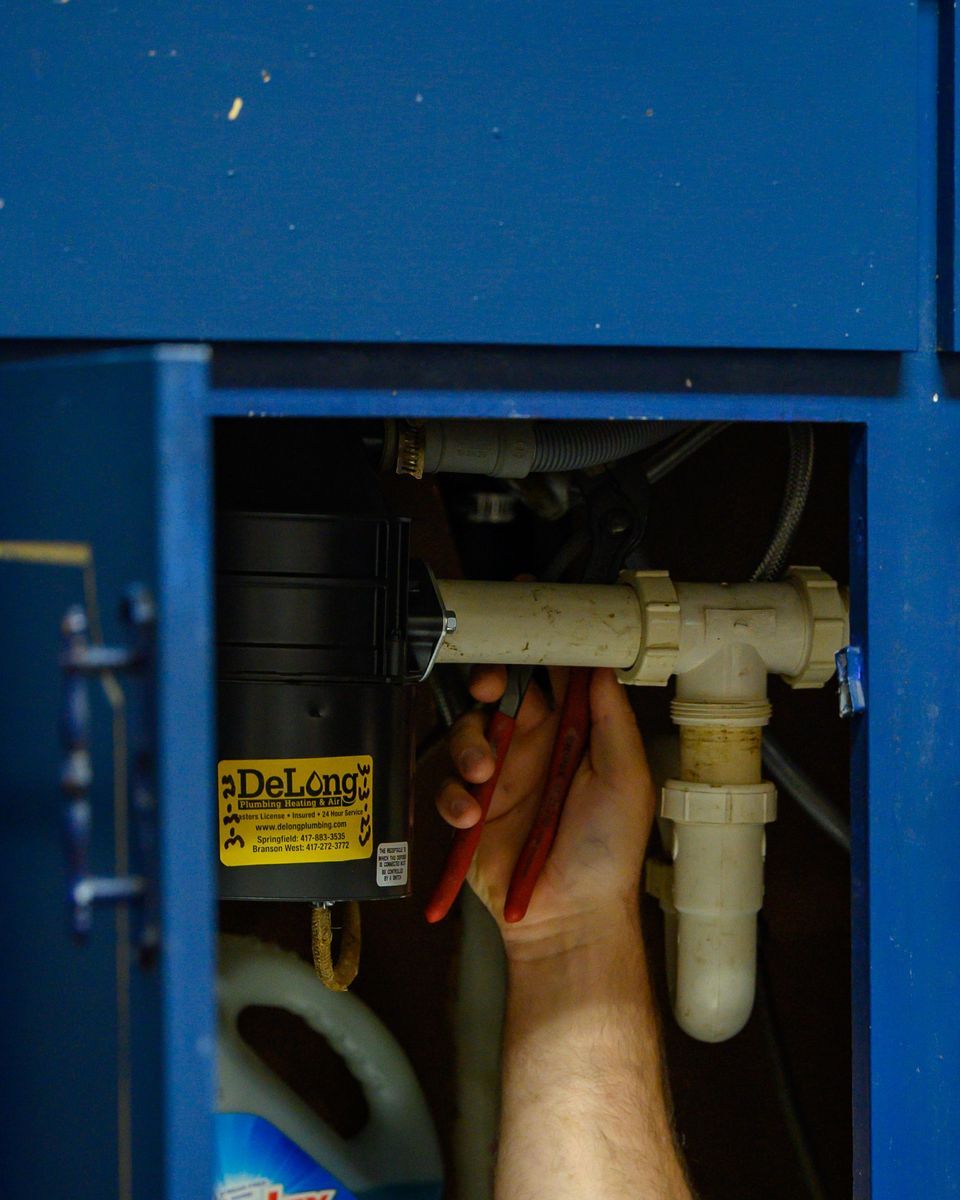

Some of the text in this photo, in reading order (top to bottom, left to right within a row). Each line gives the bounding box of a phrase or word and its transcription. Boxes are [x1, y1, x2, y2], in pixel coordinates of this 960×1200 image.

[237, 767, 359, 803] DeLong
[240, 800, 282, 809] Plumbing
[284, 799, 317, 808] Heating
[328, 798, 340, 806] Air
[260, 811, 285, 820] License
[292, 811, 316, 819] Insured
[330, 809, 344, 817] Hour
[344, 808, 364, 816] Service
[255, 820, 347, 831] www.delongplumbing.com
[257, 834, 299, 845] Springfield:
[252, 841, 350, 853] Branson West: 417-272-3772
